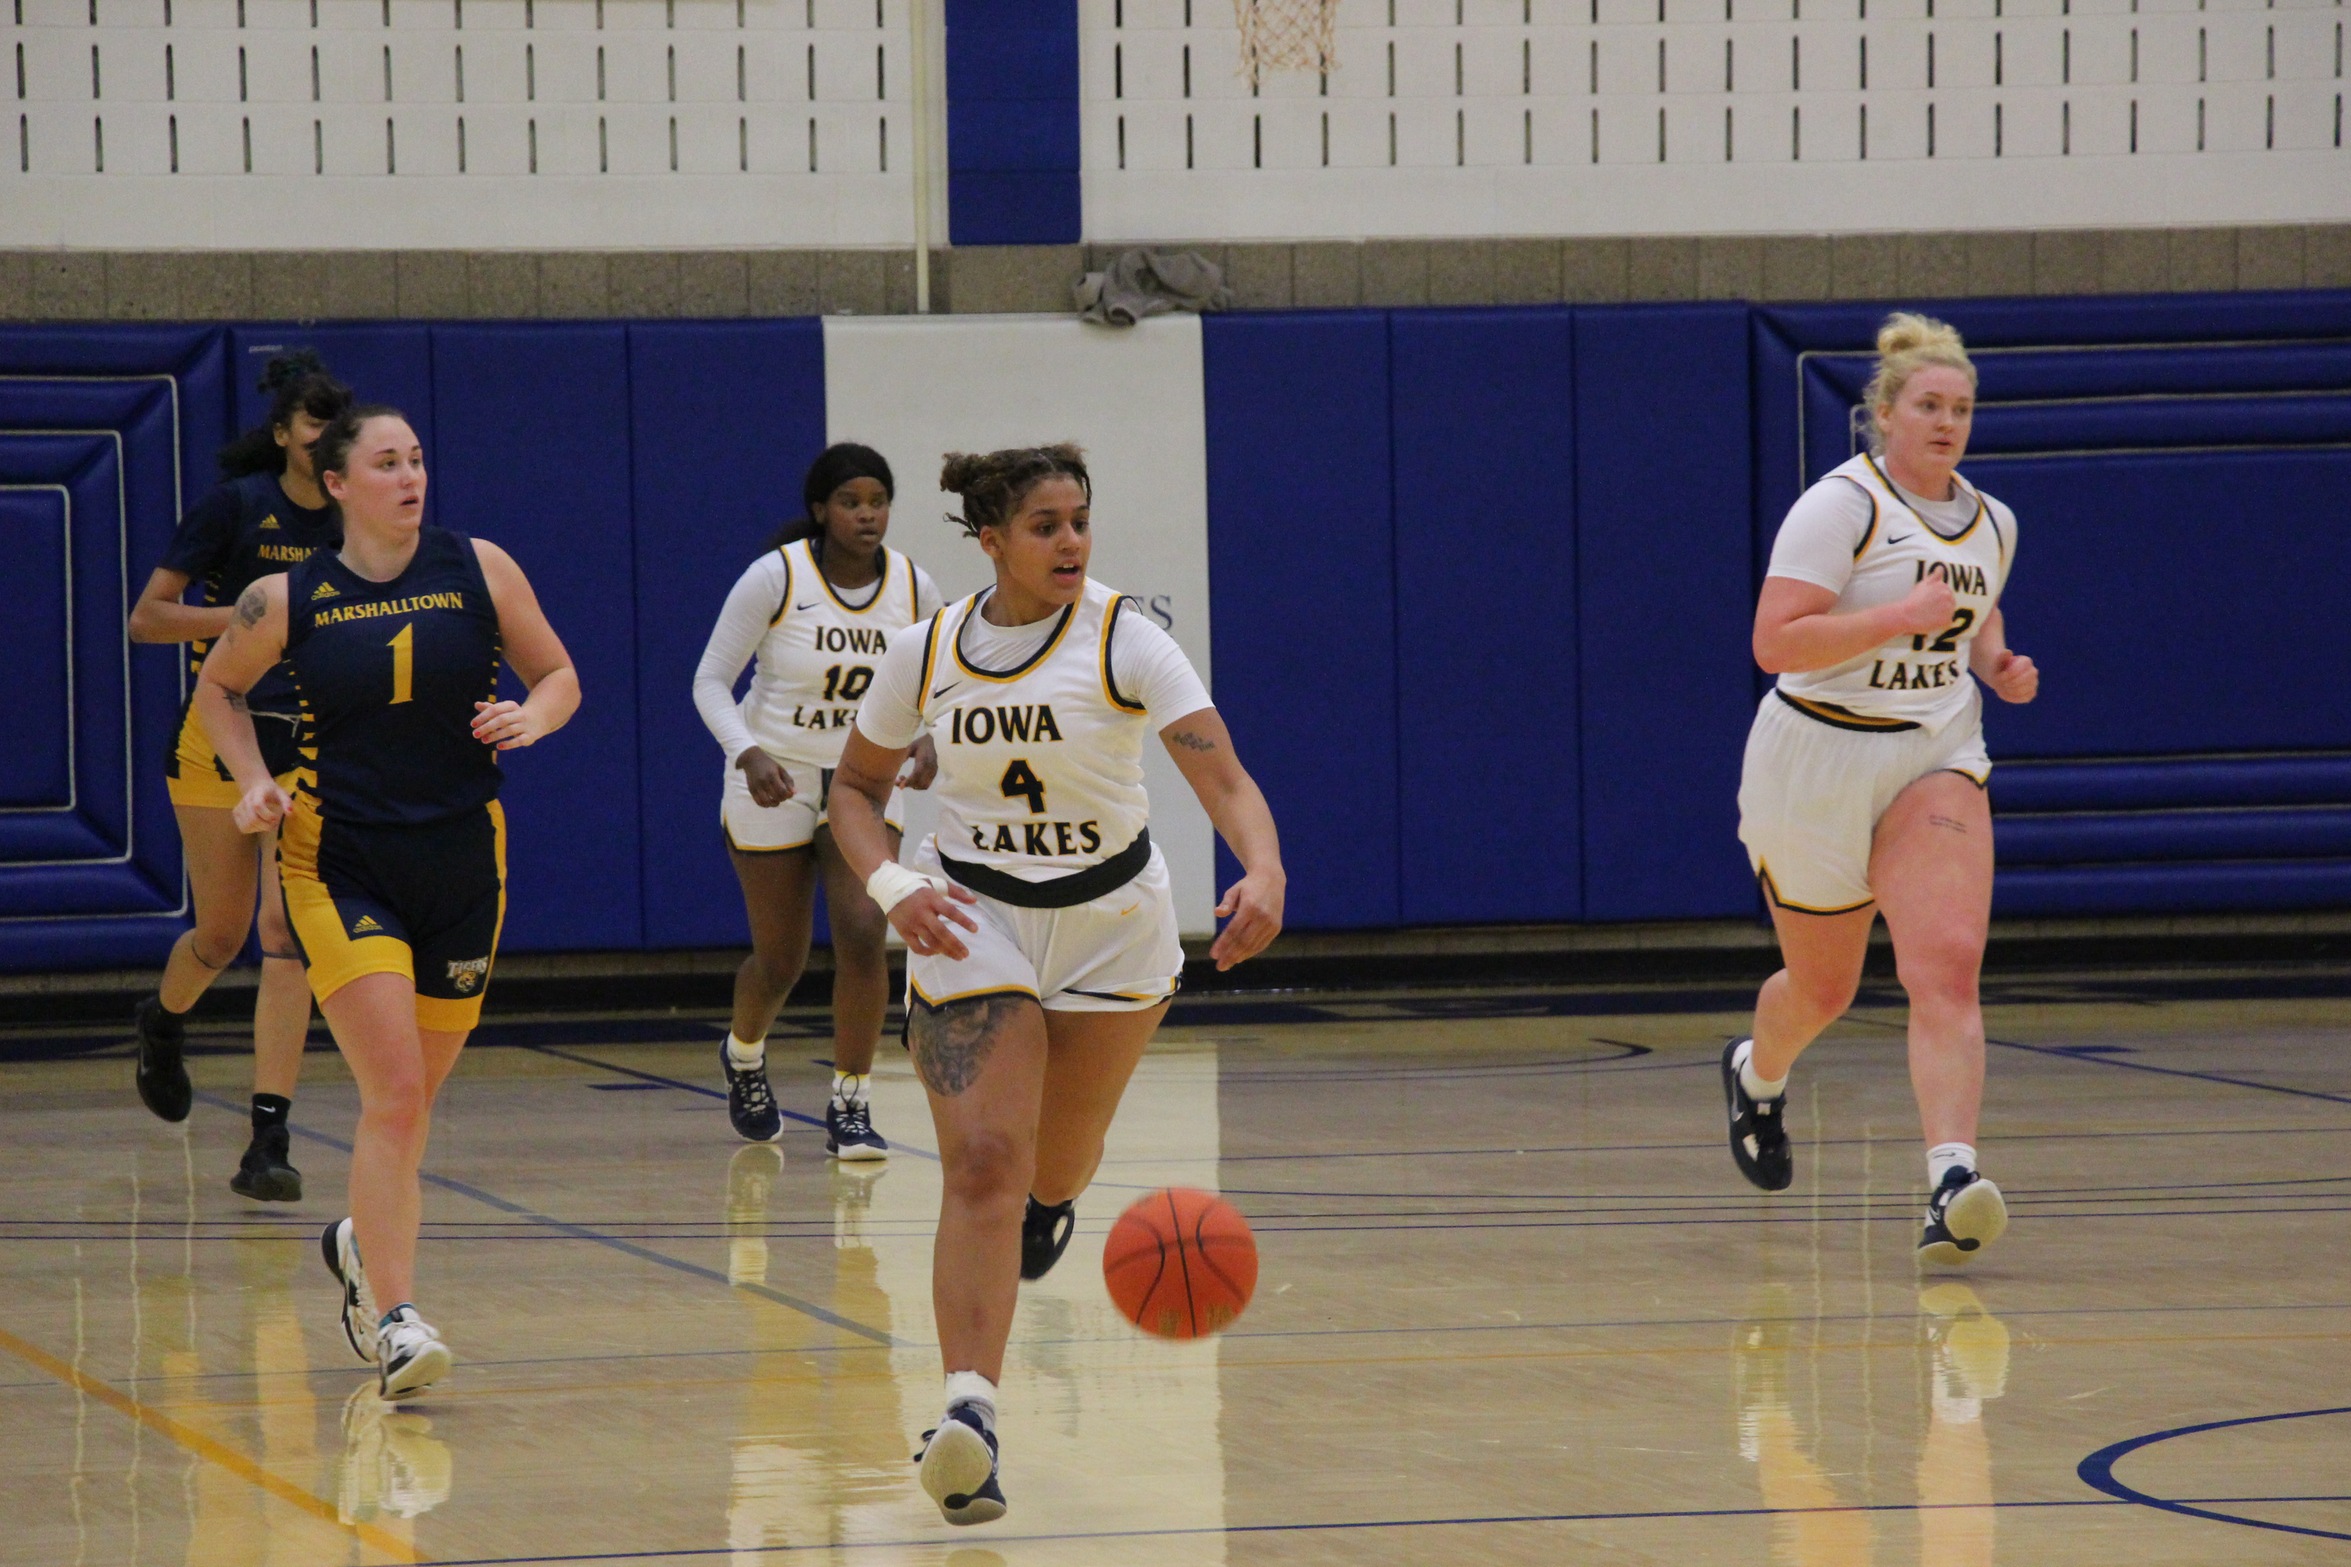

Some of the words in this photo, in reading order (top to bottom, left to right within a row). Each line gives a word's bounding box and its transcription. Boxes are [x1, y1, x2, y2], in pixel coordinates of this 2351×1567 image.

[257, 544, 320, 562] MARSHA
[1916, 559, 1988, 596] IOWA
[314, 592, 463, 628] MARSHALLTOWN
[815, 625, 887, 655] IOWA
[385, 622, 414, 705] 1
[1868, 659, 1960, 690] LAKES
[822, 663, 875, 702] 10
[950, 704, 1064, 745] IOWA
[999, 757, 1048, 816] 4
[970, 820, 1101, 857] LAKES
